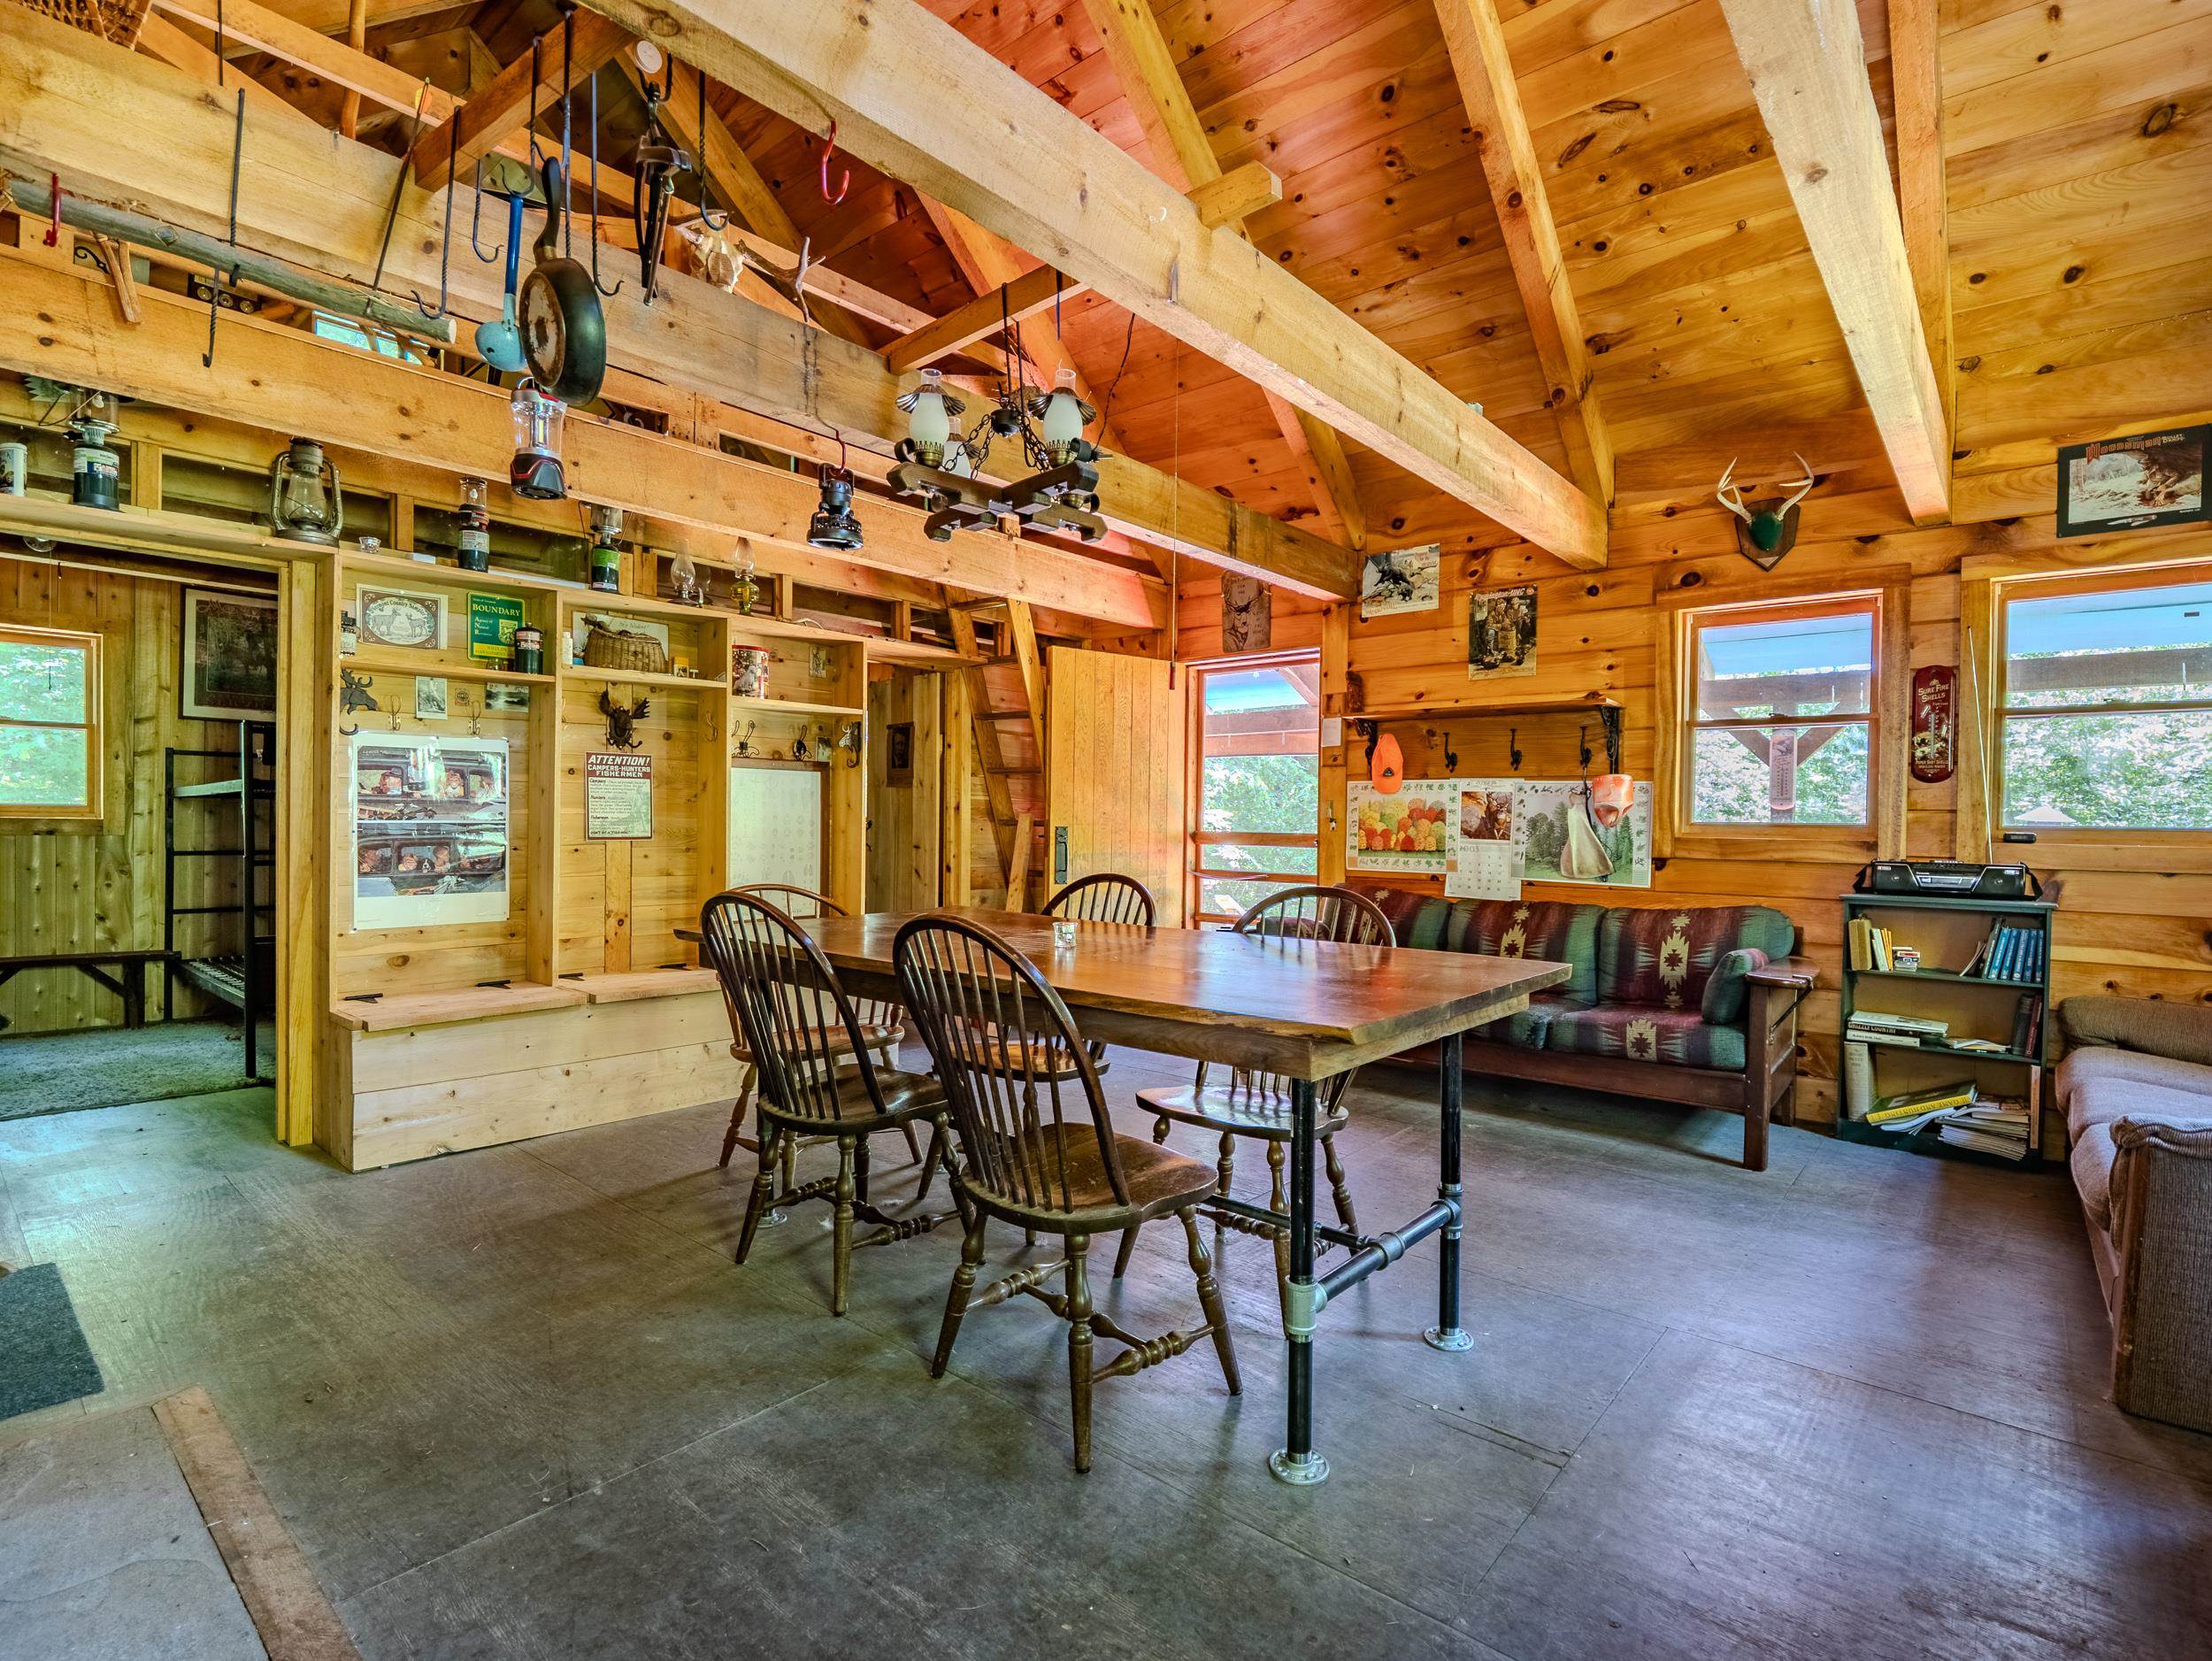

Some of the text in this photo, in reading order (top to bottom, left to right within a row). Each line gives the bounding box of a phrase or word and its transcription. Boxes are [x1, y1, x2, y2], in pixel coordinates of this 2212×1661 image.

[390, 599, 408, 608] Country
[472, 604, 520, 617] BOUNDARY
[1918, 683, 1950, 696] SURE FIRE
[1922, 692, 1946, 703] SHELLS
[588, 755, 650, 766] ATTENTION!
